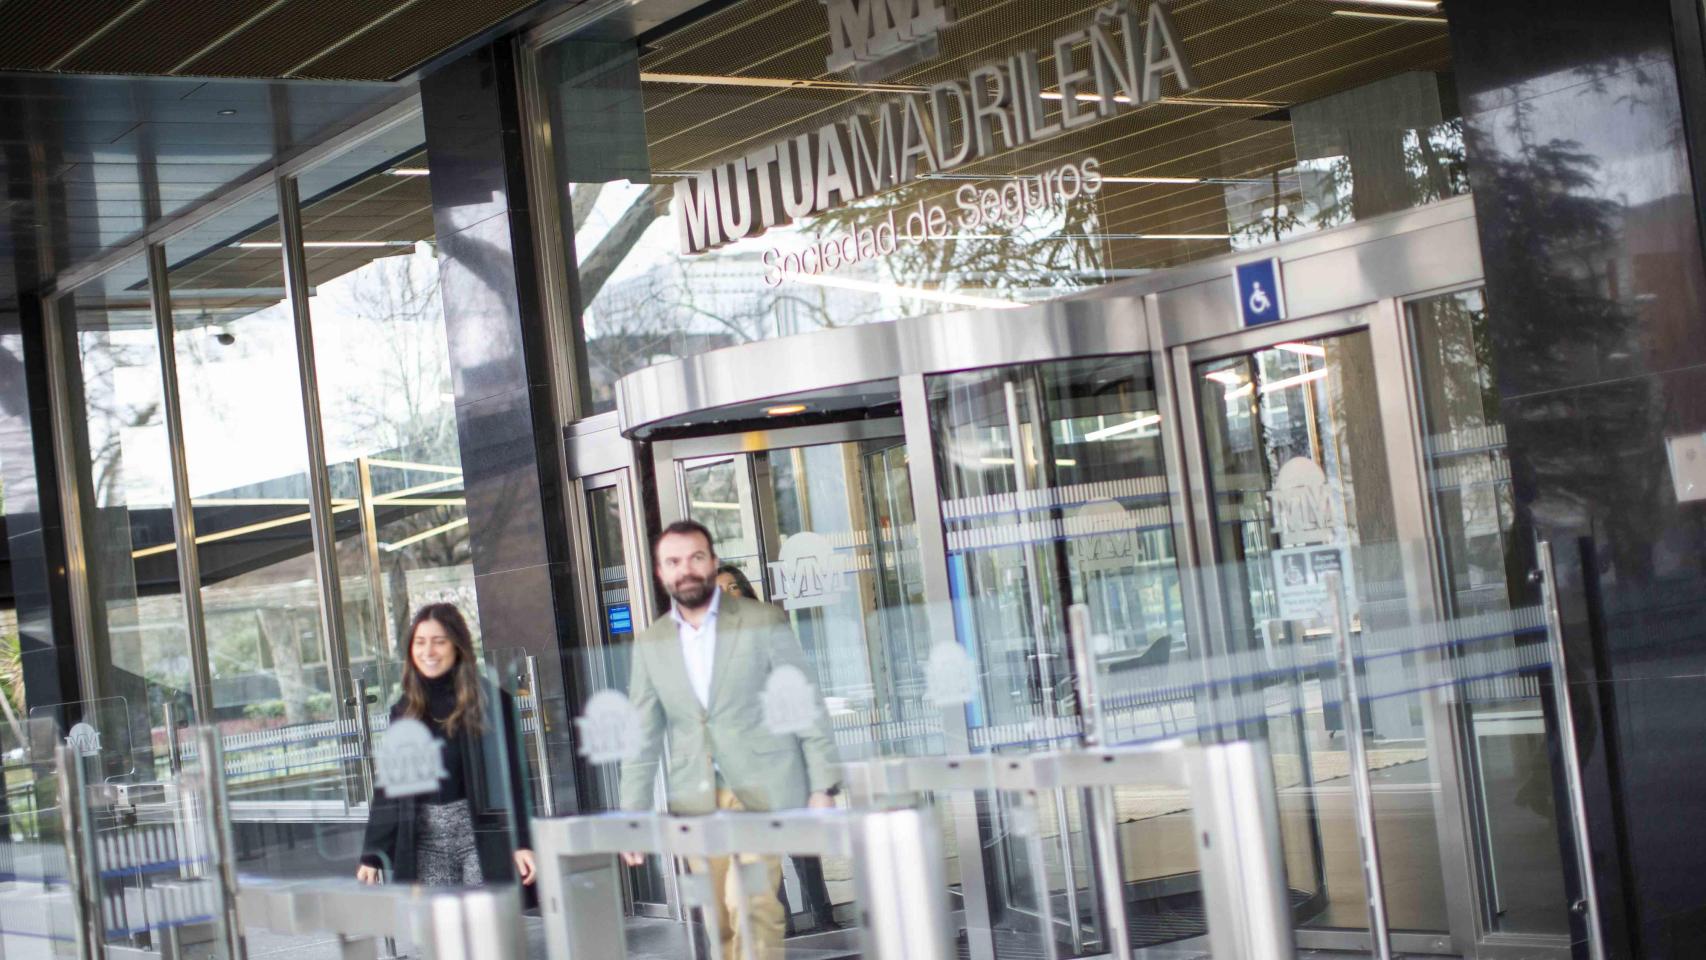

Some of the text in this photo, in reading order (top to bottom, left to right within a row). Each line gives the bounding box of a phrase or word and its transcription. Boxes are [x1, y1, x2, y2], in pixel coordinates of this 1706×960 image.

[763, 157, 1102, 288] Sociedad de Seguros
